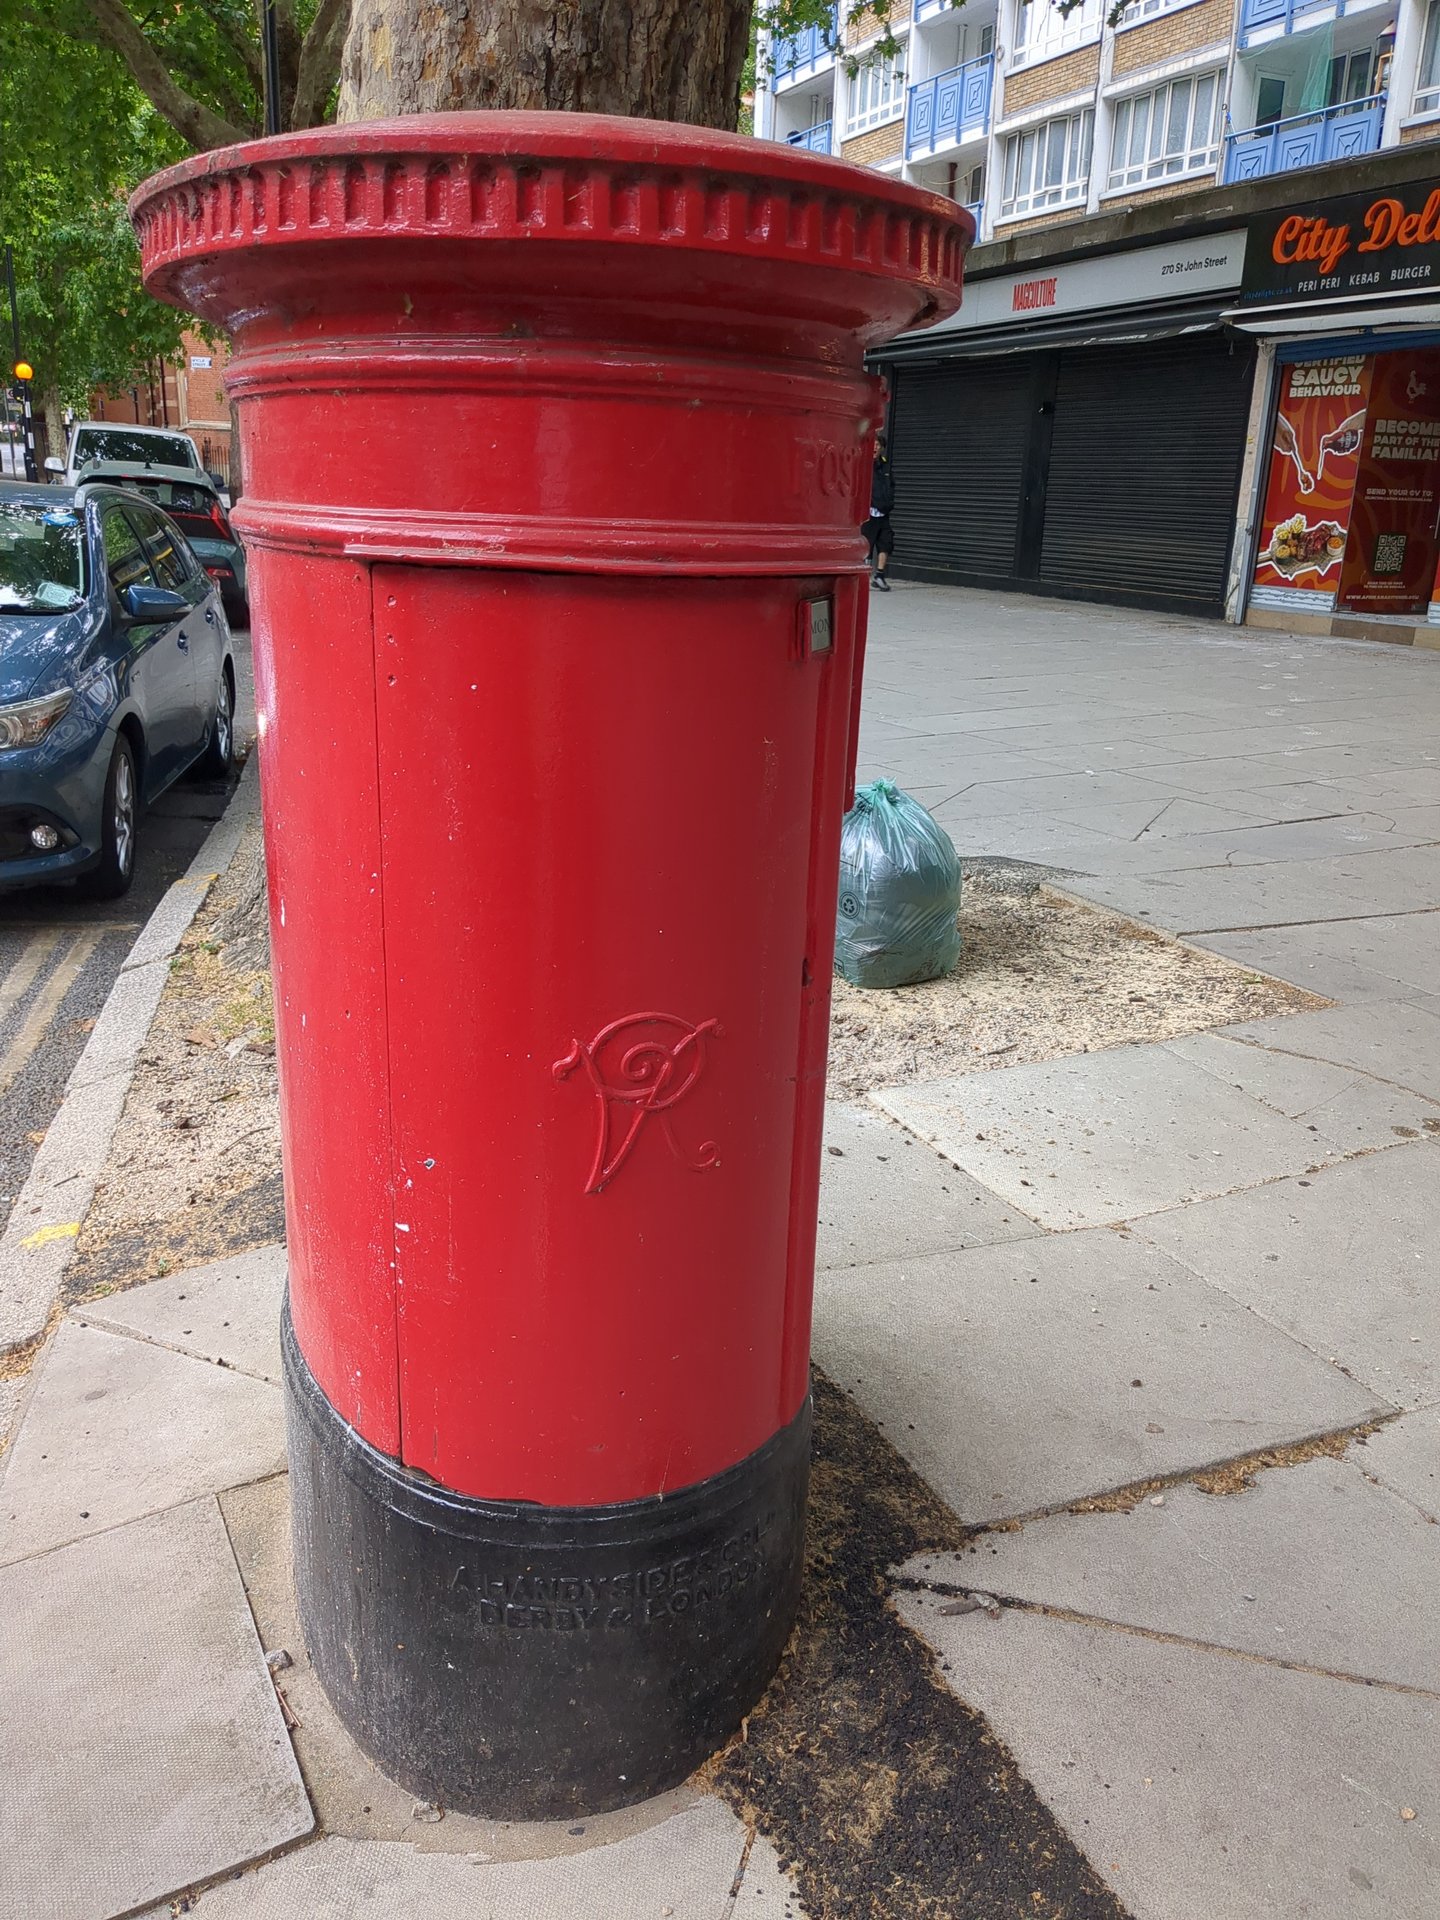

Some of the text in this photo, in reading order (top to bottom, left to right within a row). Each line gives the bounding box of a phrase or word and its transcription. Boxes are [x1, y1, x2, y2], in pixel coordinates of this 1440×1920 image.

[1272, 215, 1350, 274] City
[1161, 255, 1228, 276] 270 St John Street
[1297, 264, 1432, 293] PERI PERI KEBAB BURGER
[1011, 277, 1059, 312] MAGCULTURE
[1291, 365, 1364, 387] SAUCY
[1289, 384, 1361, 398] BEHAVIOUR
[1375, 419, 1440, 435] BECOME
[1373, 435, 1440, 447] PART OF THE
[1371, 447, 1439, 461] FAMILIA!
[1388, 488, 1408, 496] YOUR
[480, 1598, 600, 1632] DERBY
